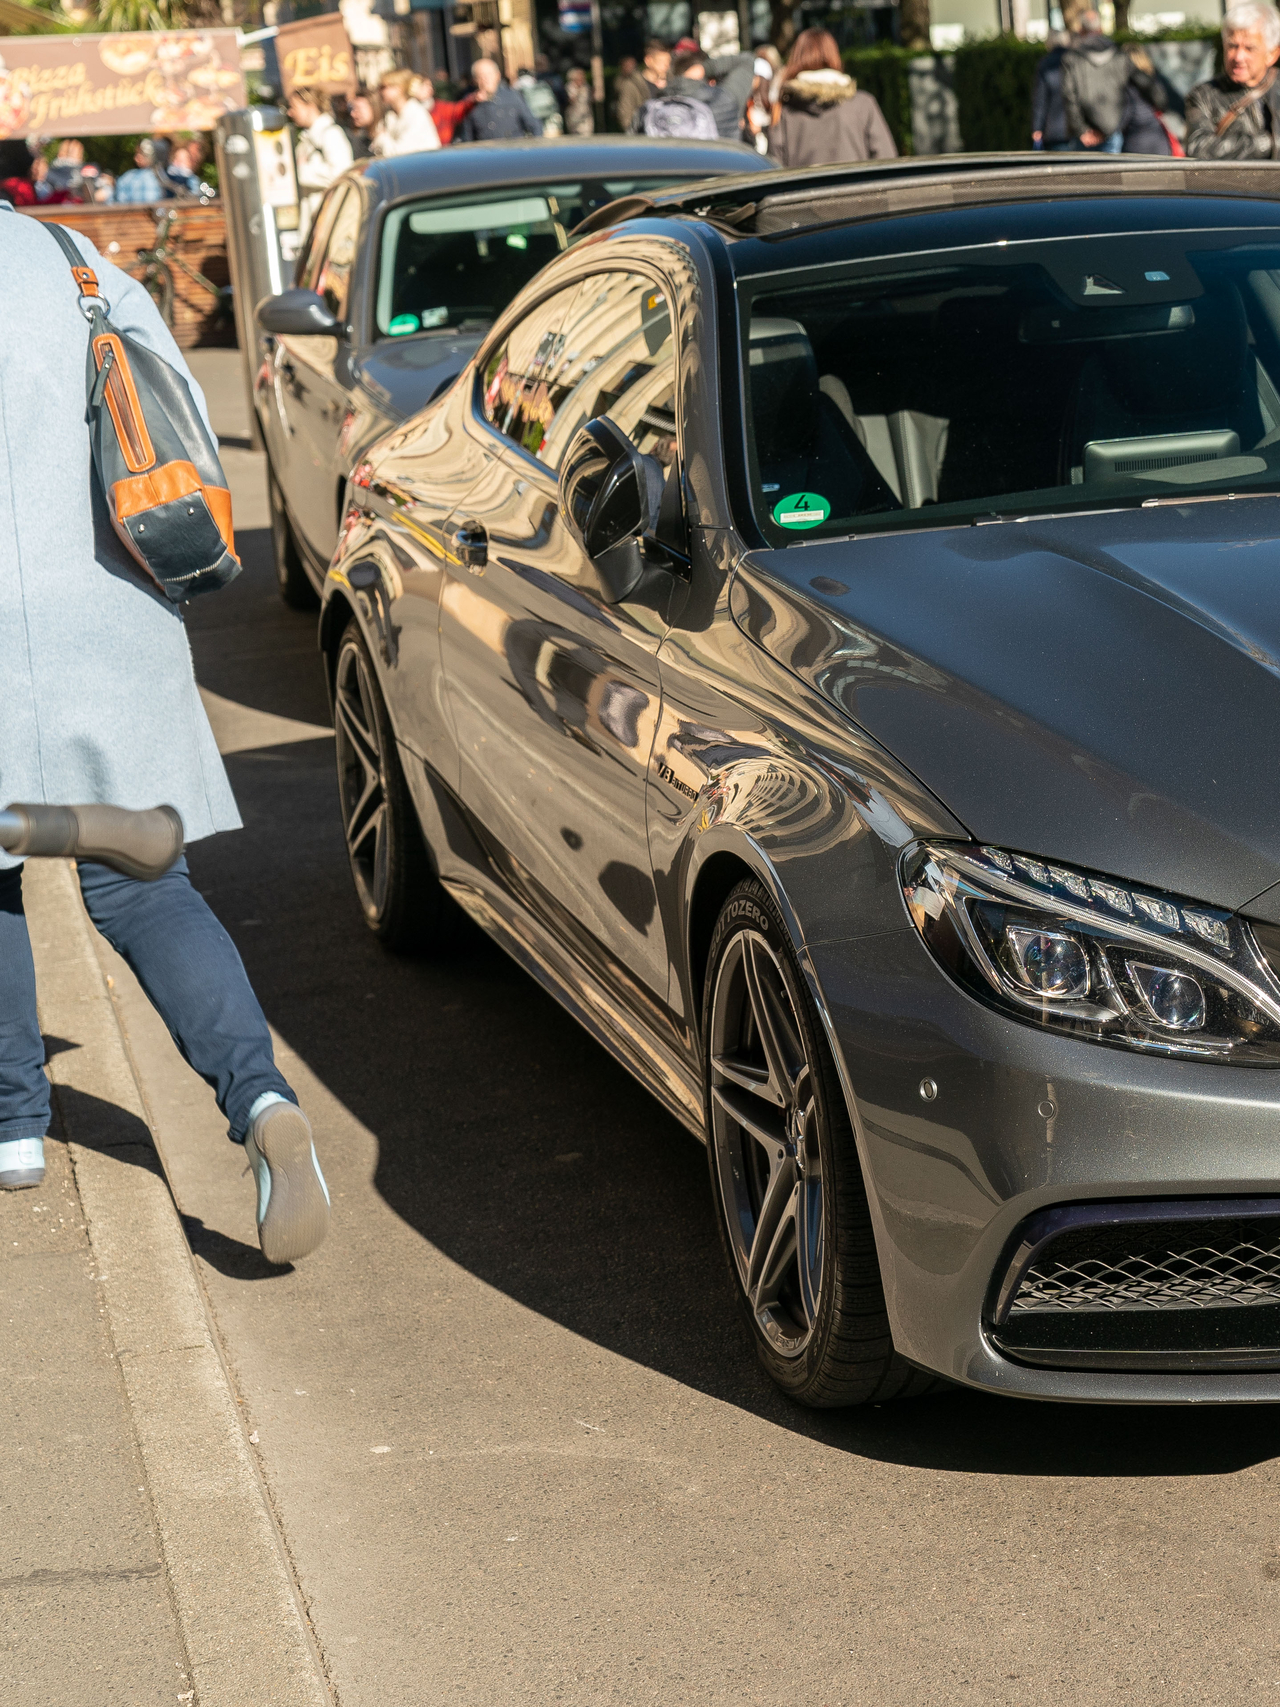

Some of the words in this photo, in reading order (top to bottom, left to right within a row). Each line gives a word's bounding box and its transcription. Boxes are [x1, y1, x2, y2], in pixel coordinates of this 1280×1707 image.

[10, 62, 87, 95] Pizza
[284, 44, 349, 86] Eis
[28, 68, 168, 129] Frühstück
[794, 494, 811, 511] 4
